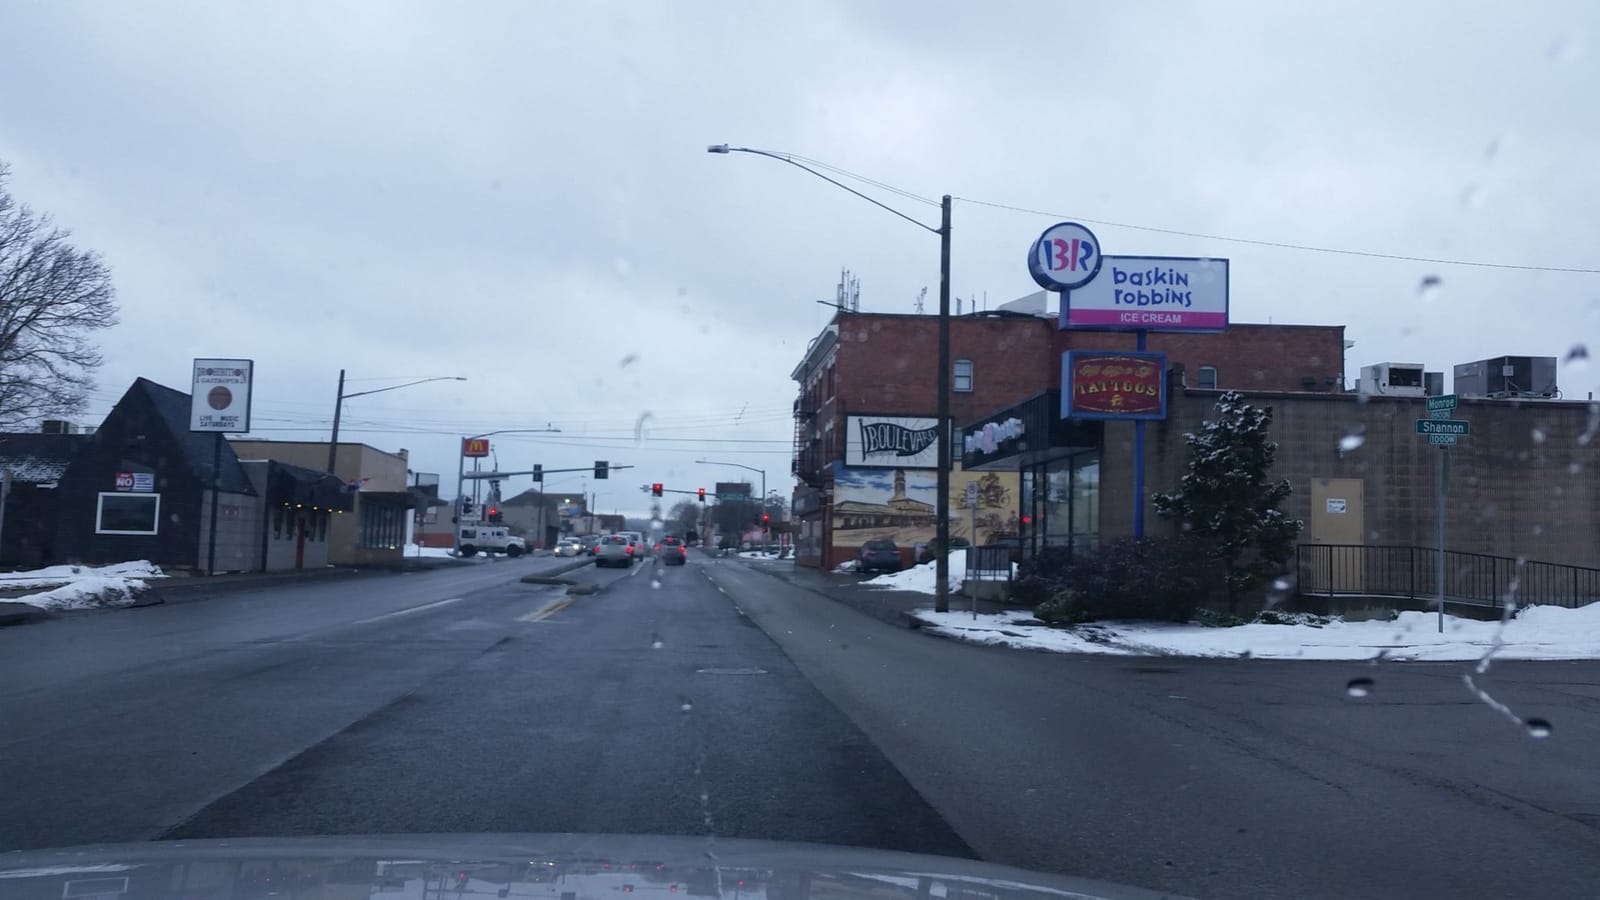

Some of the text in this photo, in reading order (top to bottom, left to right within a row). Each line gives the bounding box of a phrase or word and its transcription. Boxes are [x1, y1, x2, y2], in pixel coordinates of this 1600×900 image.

[1043, 239, 1094, 272] BR
[1112, 267, 1189, 287] baskin
[1114, 288, 1192, 308] robbins
[1120, 312, 1182, 324] ICE CREAM
[1078, 381, 1157, 396] TATTOOS
[1428, 398, 1455, 409] Monroe
[1423, 421, 1464, 433] Shannon
[867, 424, 937, 452] BOULEVARD
[116, 477, 133, 487] NO
